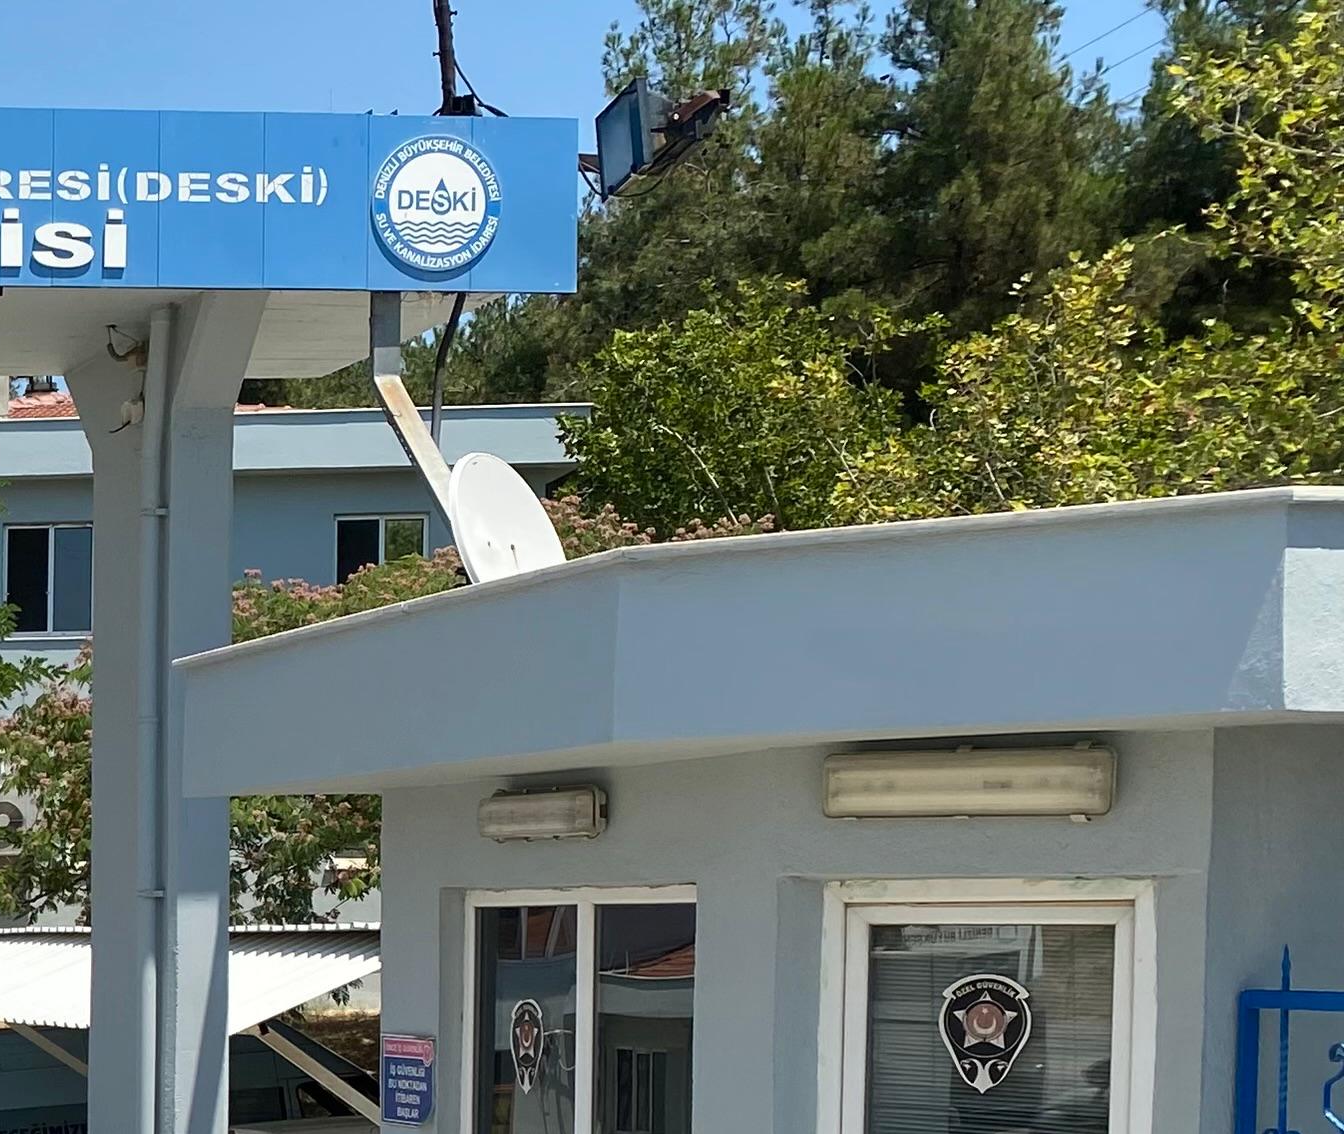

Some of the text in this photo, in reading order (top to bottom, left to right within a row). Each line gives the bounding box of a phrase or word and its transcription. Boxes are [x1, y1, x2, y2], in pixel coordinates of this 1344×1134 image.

[397, 187, 477, 213] DESKİ
[955, 981, 1017, 998] ÖZEL GÜVENLİK
